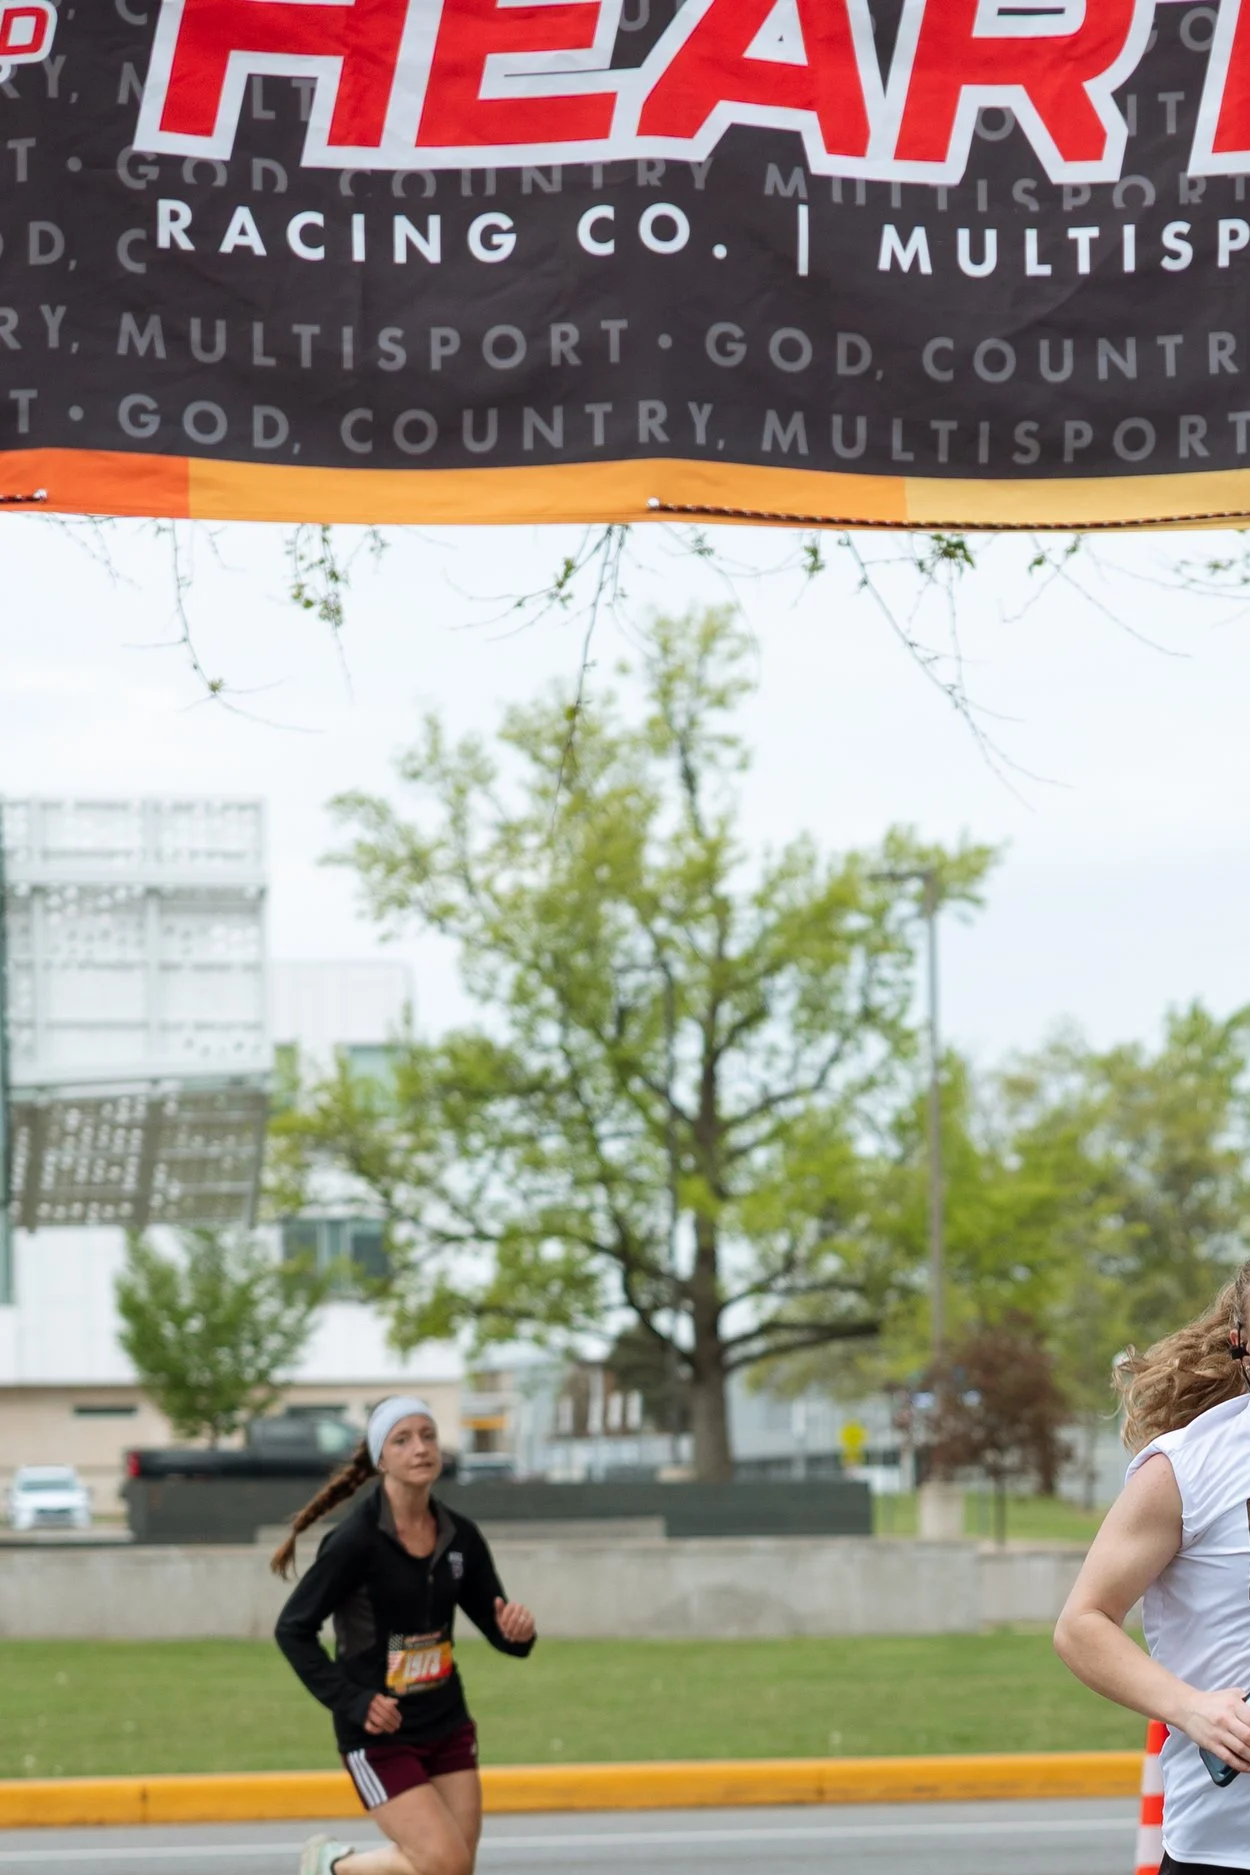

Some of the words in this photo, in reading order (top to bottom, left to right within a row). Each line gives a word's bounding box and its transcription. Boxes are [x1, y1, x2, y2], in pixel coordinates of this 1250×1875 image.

[158, 200, 518, 265] RACING
[578, 204, 728, 260] CO.
[117, 313, 630, 373] MULTISPORT
[705, 322, 884, 381] GOD,
[118, 393, 302, 456] GOD,
[341, 399, 727, 456] COUNTRY,
